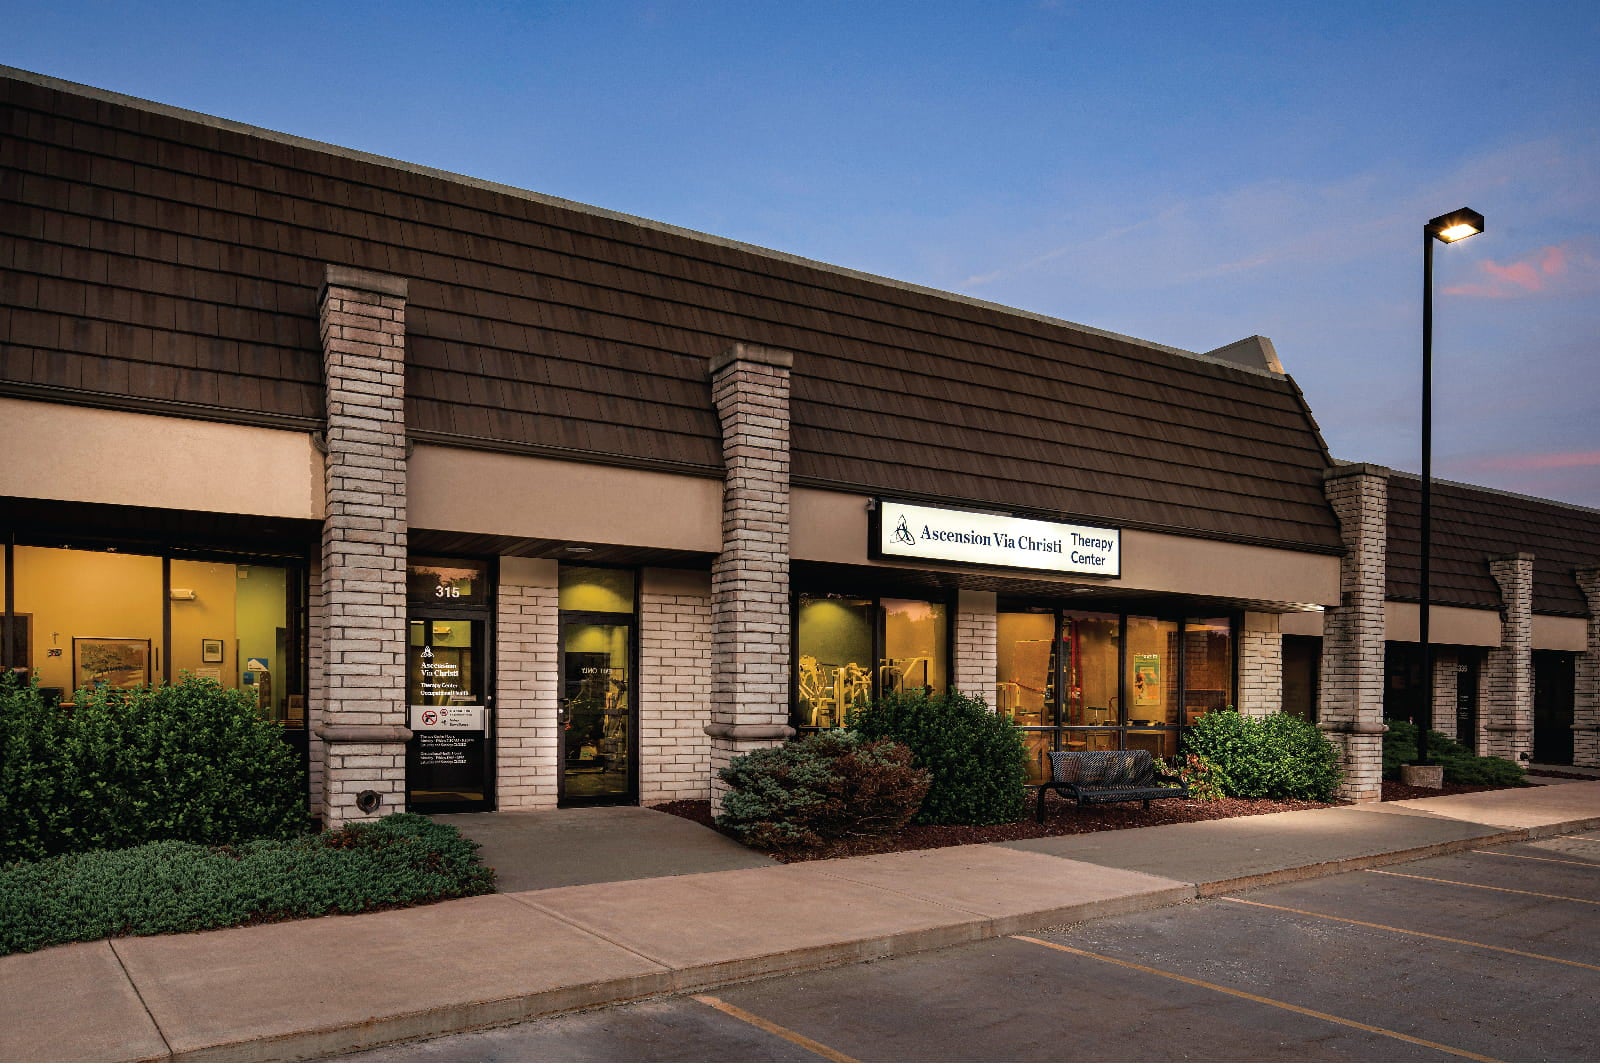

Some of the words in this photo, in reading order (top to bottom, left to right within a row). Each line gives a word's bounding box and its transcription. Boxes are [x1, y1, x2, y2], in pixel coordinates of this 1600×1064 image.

[920, 524, 991, 547] Ascension
[993, 532, 1015, 549] Via
[1018, 535, 1062, 554] Christi
[1070, 532, 1114, 552] Therapy
[1070, 551, 1106, 566] Center
[435, 585, 460, 598] 315
[420, 669, 433, 677] Via
[434, 669, 459, 677] Christi
